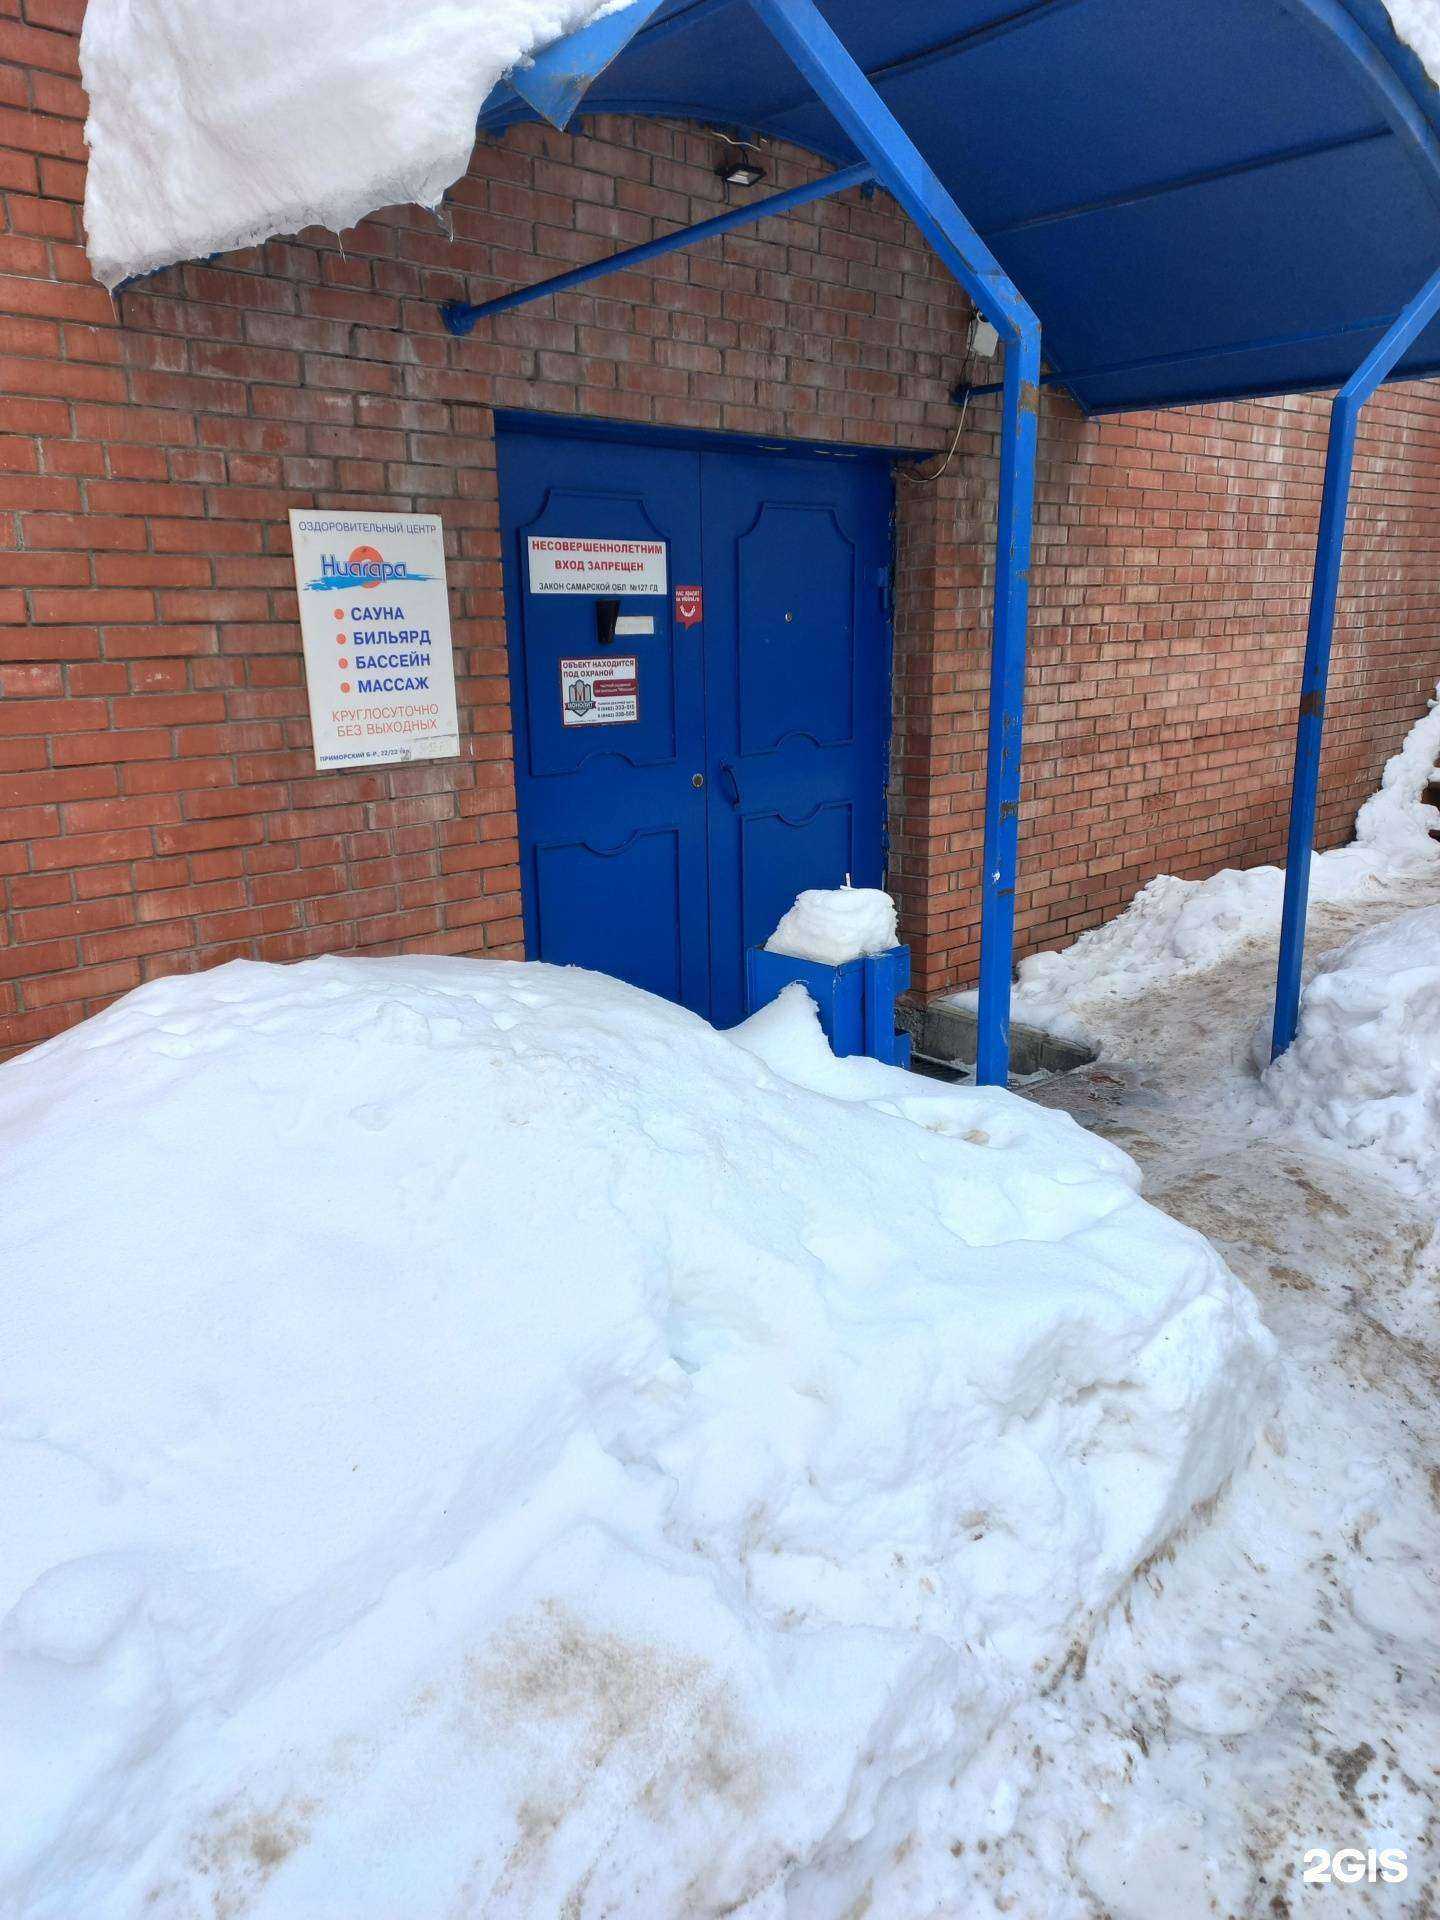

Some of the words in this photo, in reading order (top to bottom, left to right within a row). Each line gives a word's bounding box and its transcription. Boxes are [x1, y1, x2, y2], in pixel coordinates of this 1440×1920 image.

[298, 521, 404, 534] ОЗДОРОВИТЕЛЬНЫЙ
[406, 524, 437, 535] ЦЕНТР
[531, 540, 663, 555] НЕСОВЕРШЕННОЛЕТНИМ
[321, 553, 407, 582] Ниагара
[554, 560, 585, 571] ВХОД
[587, 560, 644, 572] ЗАПРЕЩЕН
[538, 582, 565, 591] ЗАКОН
[566, 582, 610, 592] САМАРСКОЙ
[649, 585, 659, 593] ГД
[351, 607, 405, 621] САУНА
[353, 629, 432, 646] БИЛЬЯРД
[355, 651, 431, 670] БАССЕЙН
[562, 661, 591, 670] ОБЪЕКТ
[592, 660, 634, 669] НАХОДИТСЯ
[563, 670, 579, 679] ПОД
[580, 669, 614, 678] ОХРАНОЙ
[358, 676, 430, 694] МАССАЖ
[331, 703, 439, 723] КРУГЛОСУТОЧНО
[337, 723, 362, 738] БЕЗ
[367, 719, 438, 736] ВЫХОДНЫХ
[319, 752, 365, 762] ПРИМОРСКИЙ
